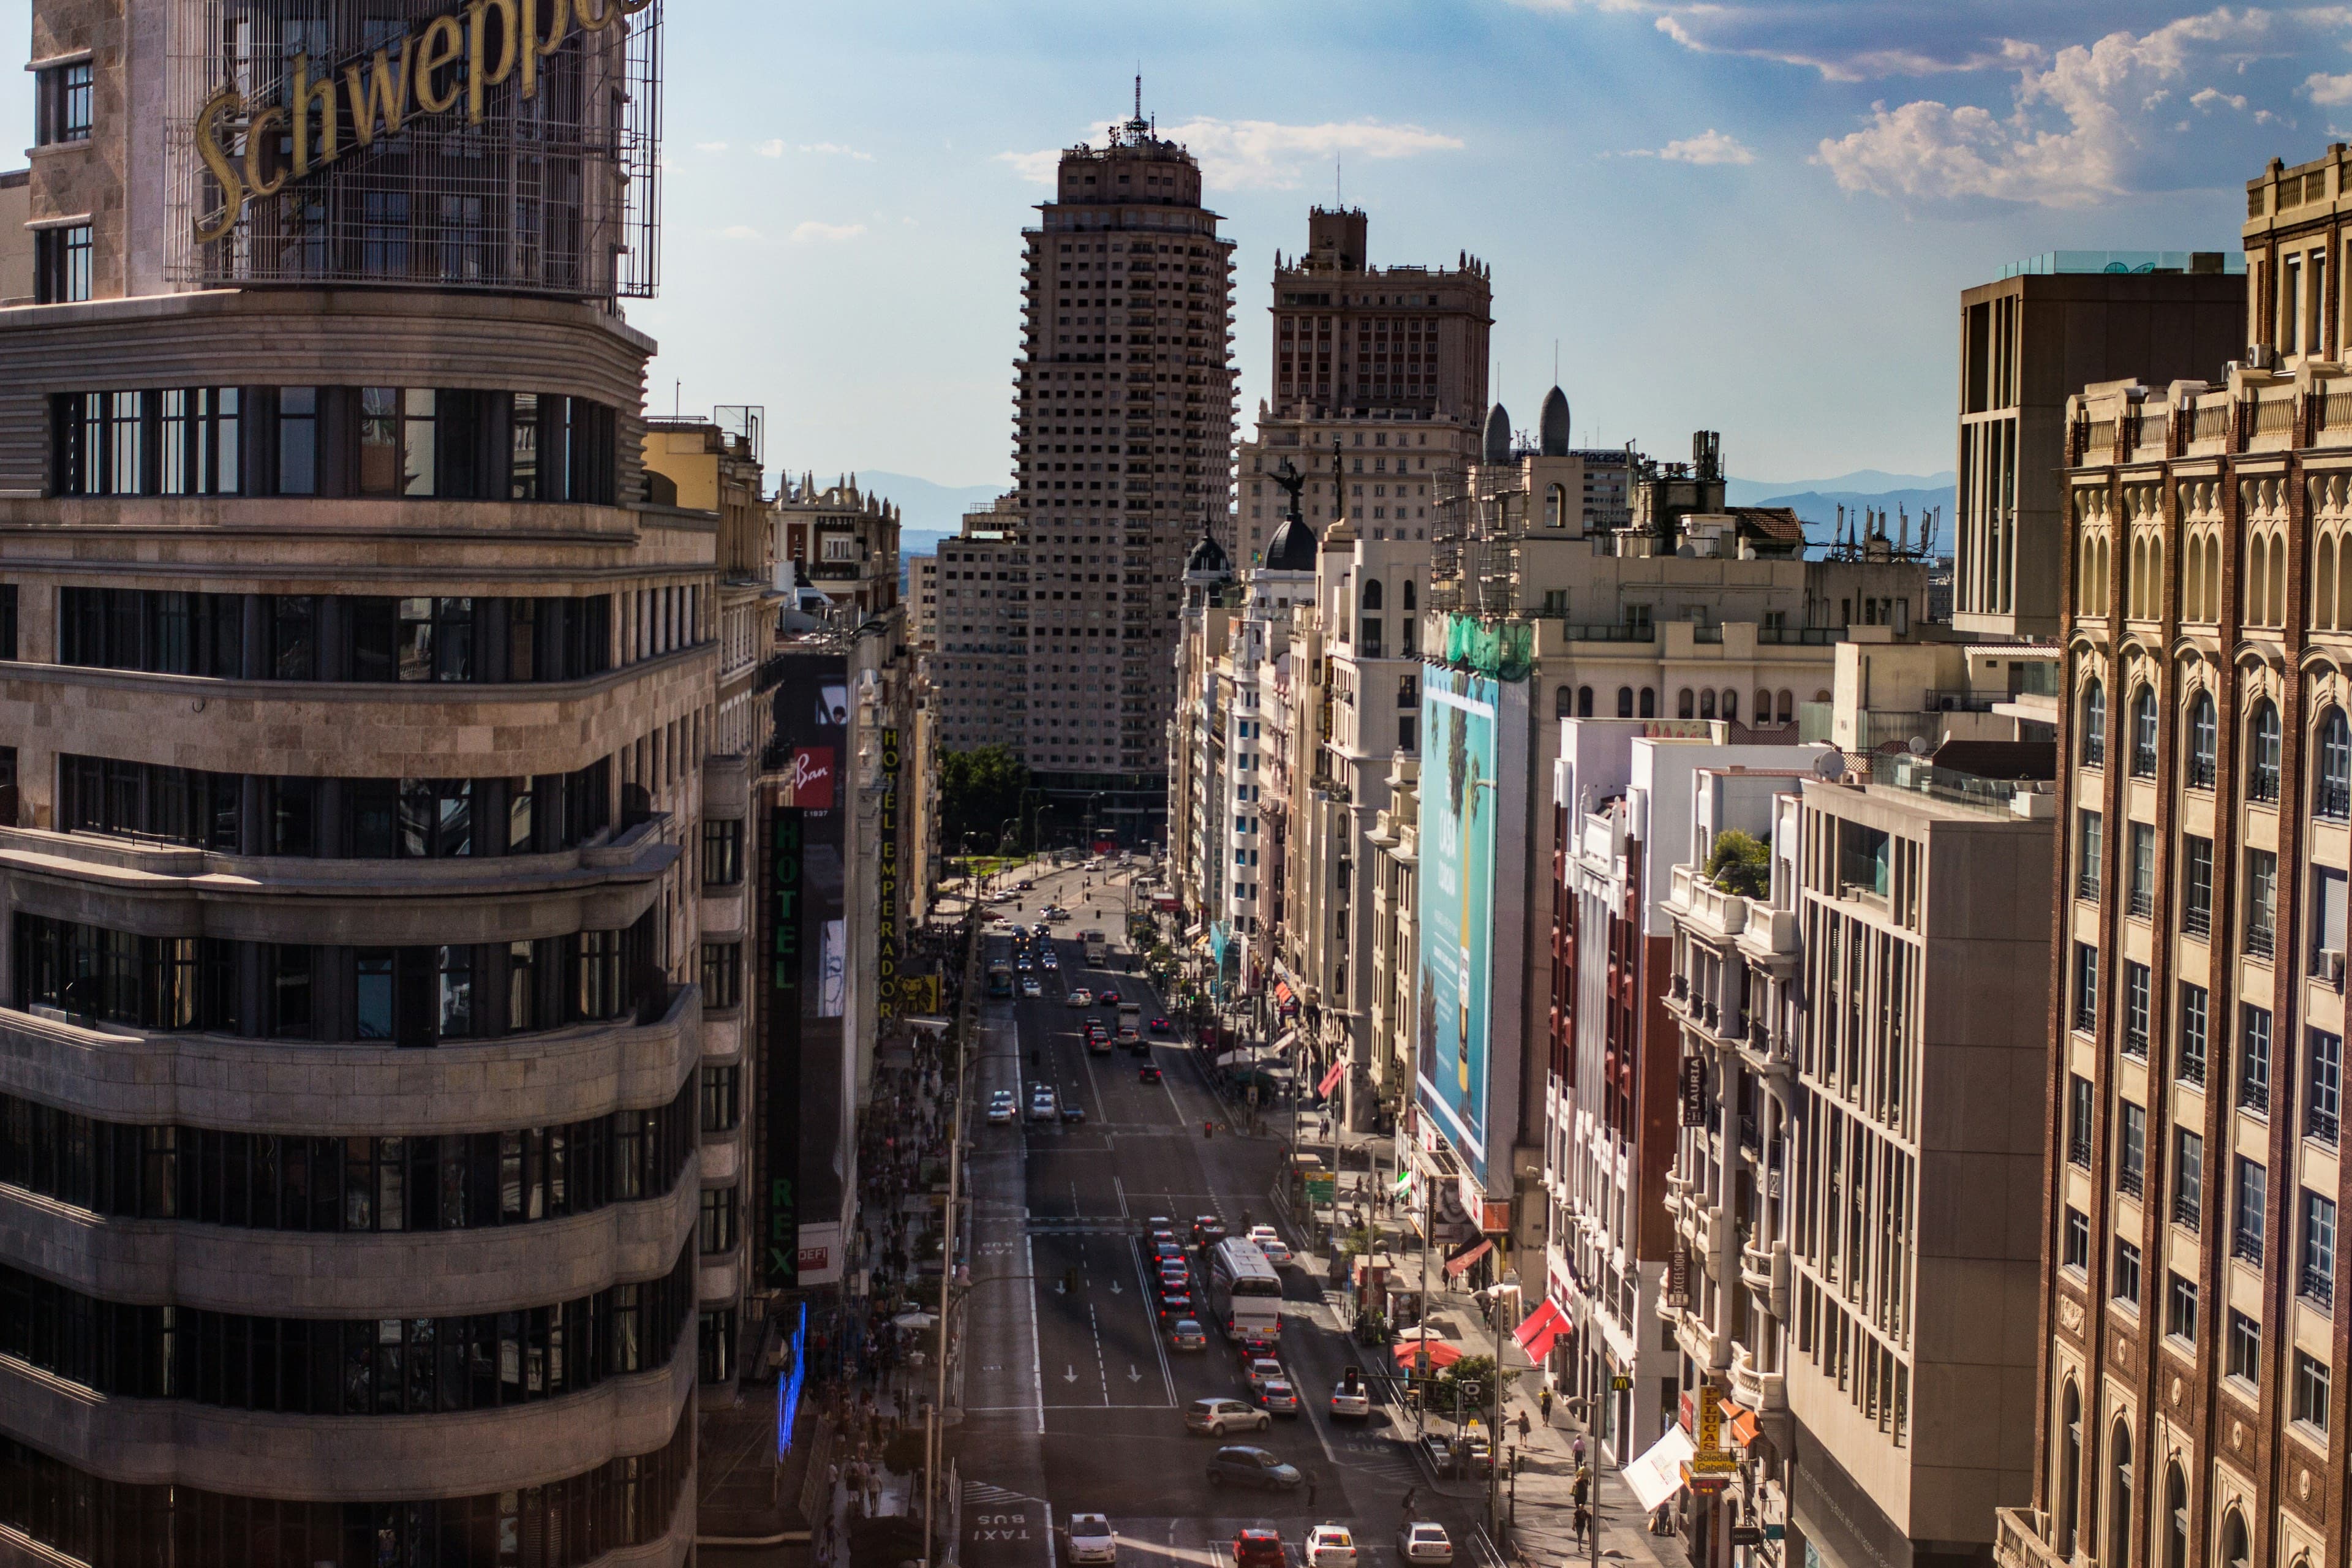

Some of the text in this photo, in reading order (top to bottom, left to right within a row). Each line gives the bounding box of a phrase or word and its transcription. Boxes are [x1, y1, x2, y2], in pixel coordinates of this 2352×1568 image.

[193, 0, 650, 244] Schwepp
[796, 753, 829, 790] Ban
[776, 820, 796, 989] HOTEL
[880, 842, 896, 1017] EMPERADOR
[1691, 1058, 1700, 1110] LAURIA
[771, 1178, 794, 1276] REX
[1673, 1254, 1686, 1294] EXCELSIOR
[1703, 1387, 1719, 1451] PELUCAS
[1346, 1443, 1390, 1454] BUS
[1697, 1453, 1733, 1462] Soleda
[1697, 1463, 1733, 1472] Cabello
[973, 1529, 1030, 1540] TAXI
[978, 1513, 1025, 1525] BUS
[1763, 1538, 1776, 1561] GEOX
